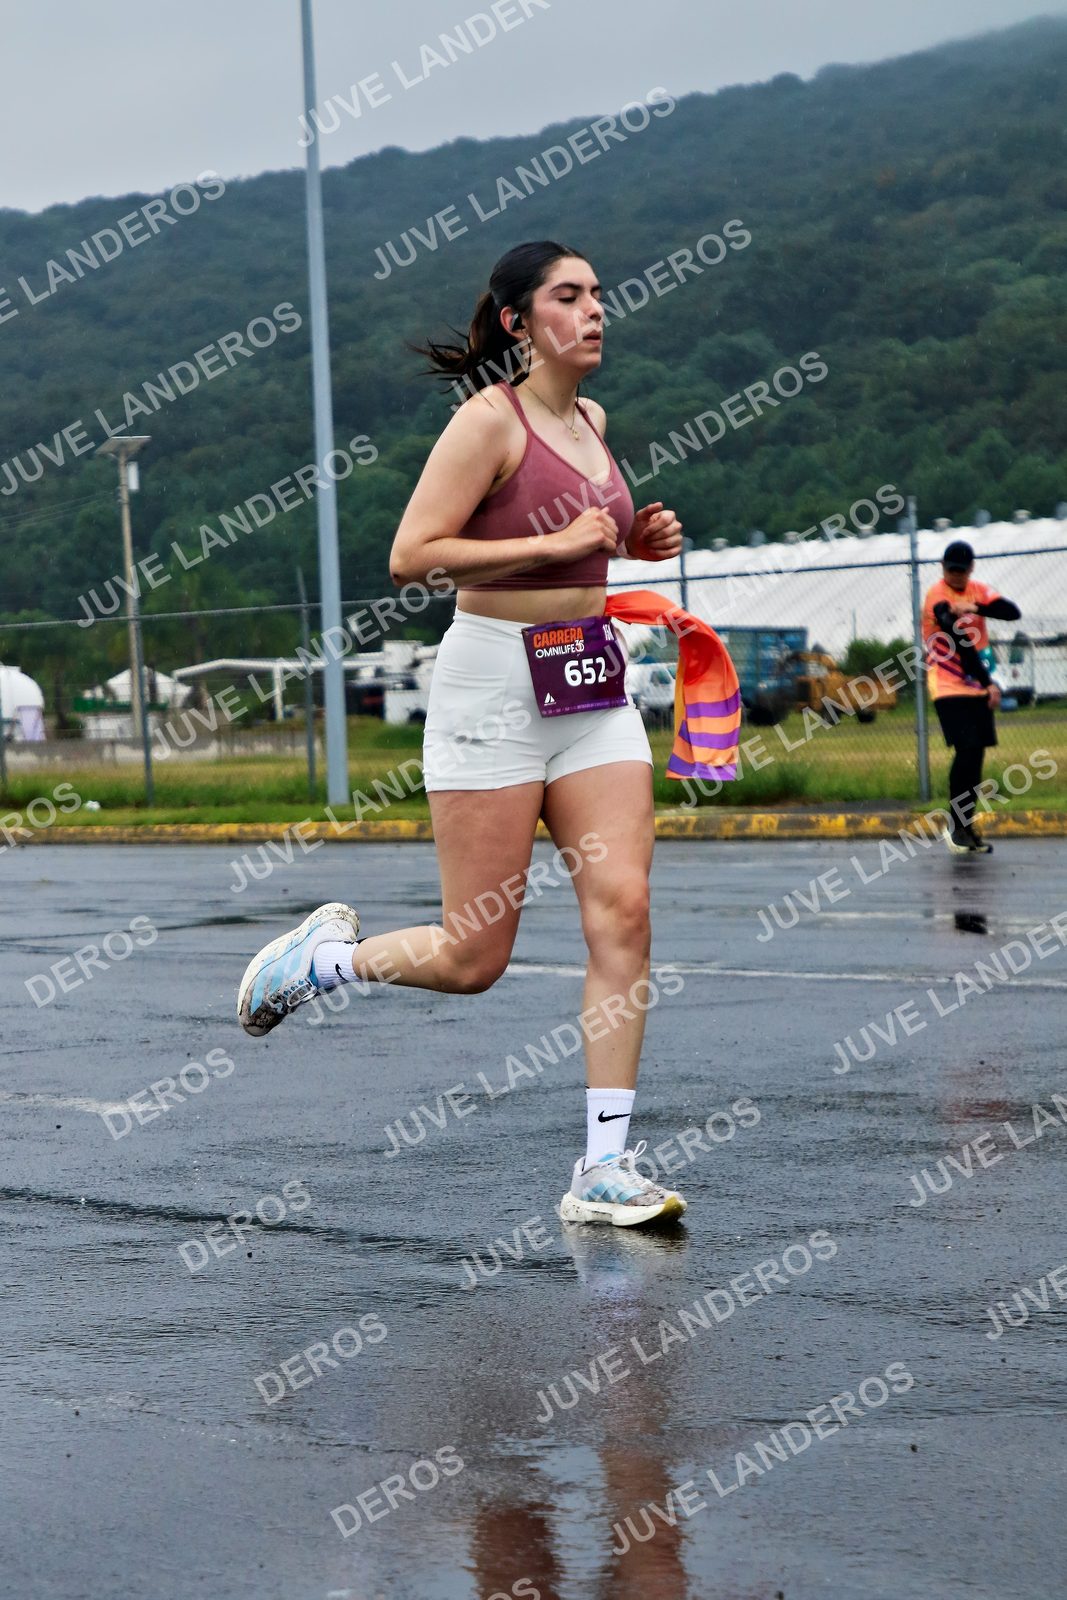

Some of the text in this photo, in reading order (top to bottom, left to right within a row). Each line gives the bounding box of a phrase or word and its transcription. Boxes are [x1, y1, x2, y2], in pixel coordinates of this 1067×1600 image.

[533, 626, 584, 649] CARRERA
[535, 644, 576, 659] OMNILIFE
[564, 656, 607, 687] 652
